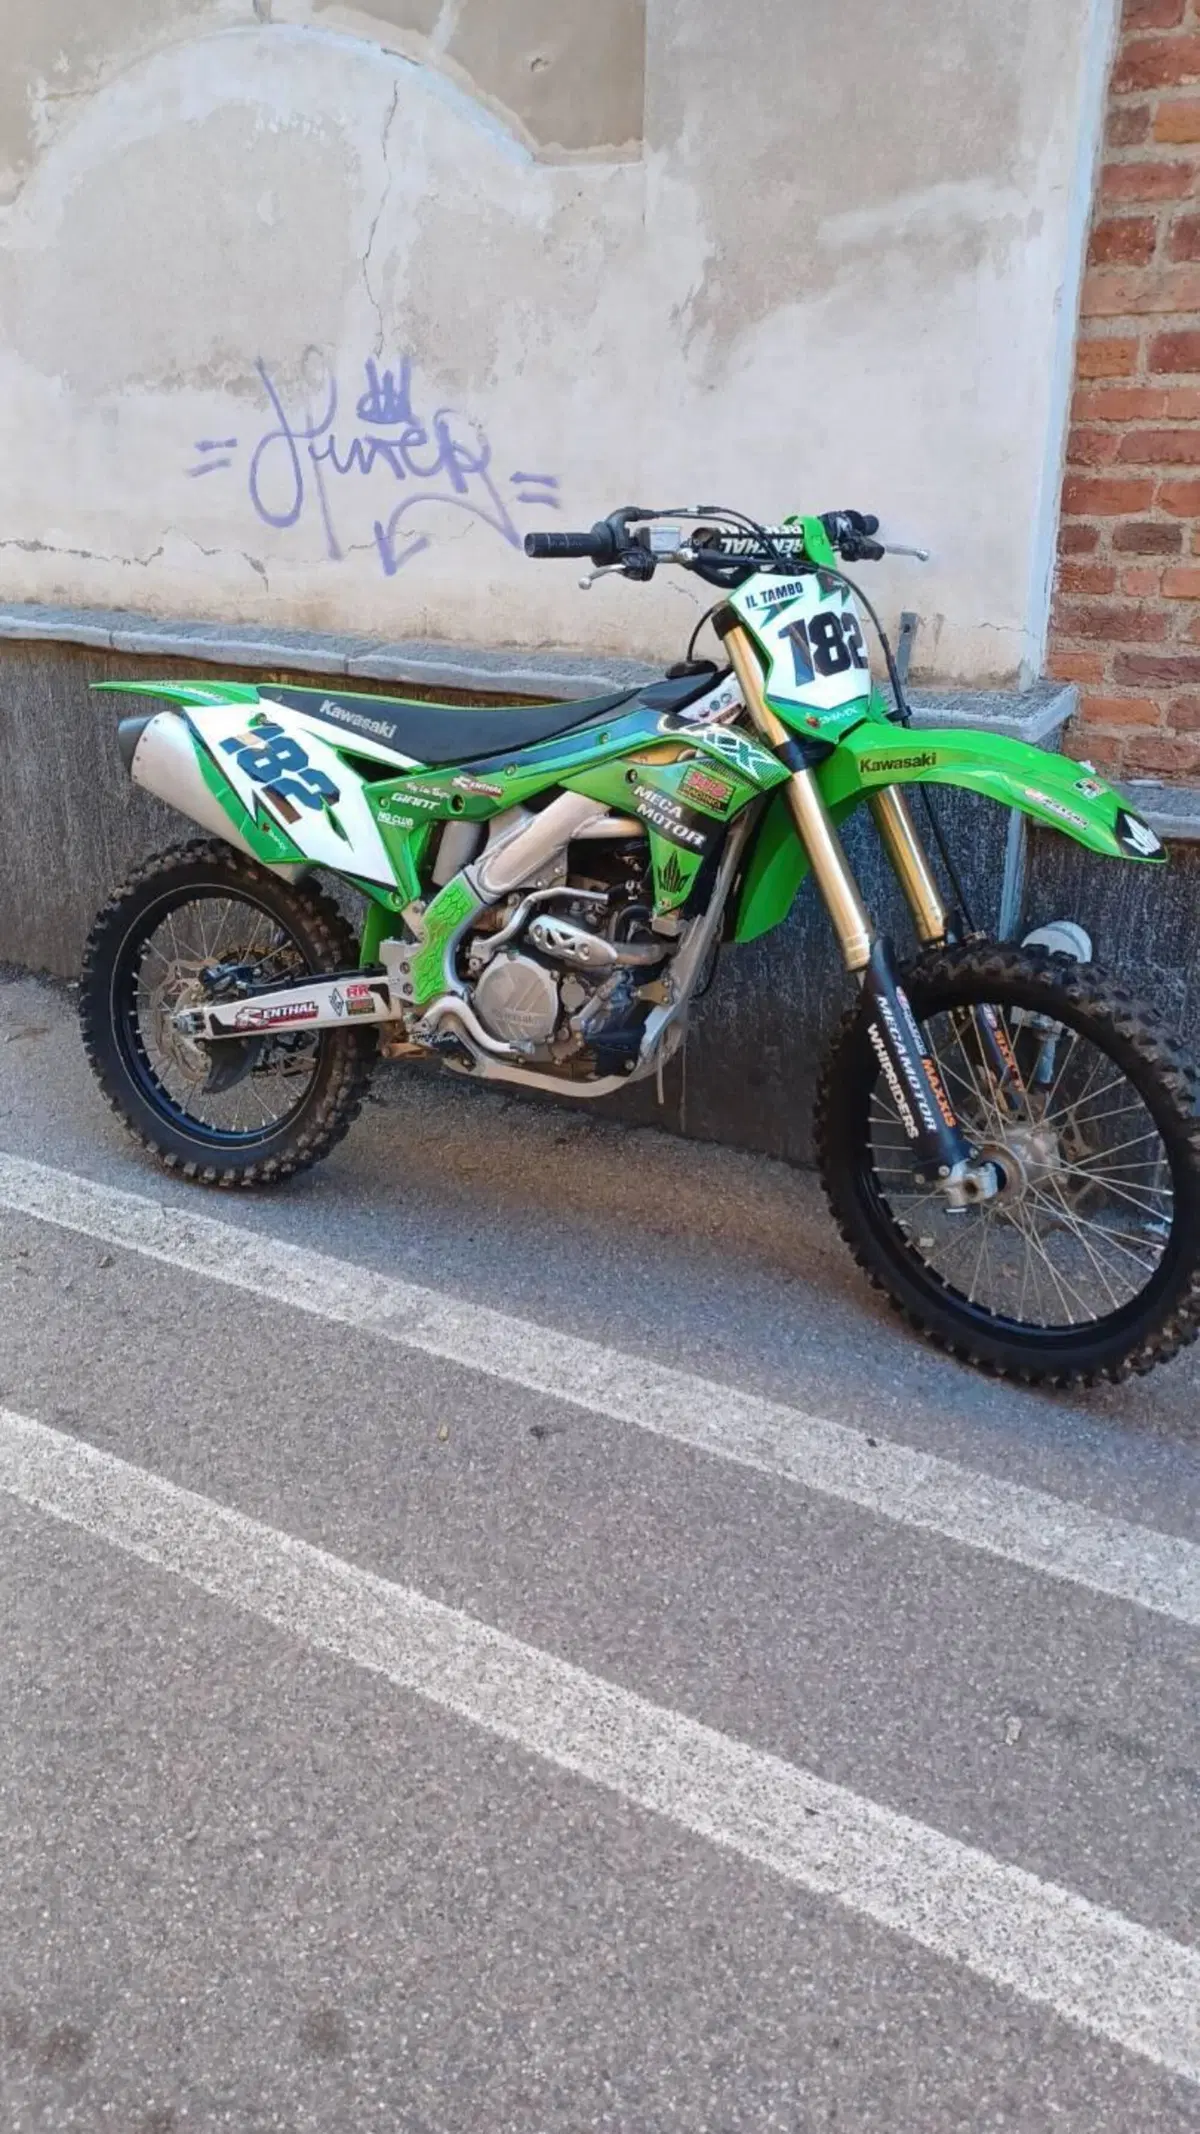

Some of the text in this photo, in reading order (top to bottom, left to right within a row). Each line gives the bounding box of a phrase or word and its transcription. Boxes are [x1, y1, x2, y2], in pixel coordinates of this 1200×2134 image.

[745, 581, 804, 609] IL TAMBO
[777, 611, 869, 687] 182
[319, 699, 398, 739] Kawasaki
[218, 722, 341, 825] 182
[859, 752, 937, 773] Kawasaki
[636, 803, 706, 845] MOTOR
[868, 1023, 919, 1139] WHIPRIDERS
[922, 1058, 957, 1127] MAXXIS
